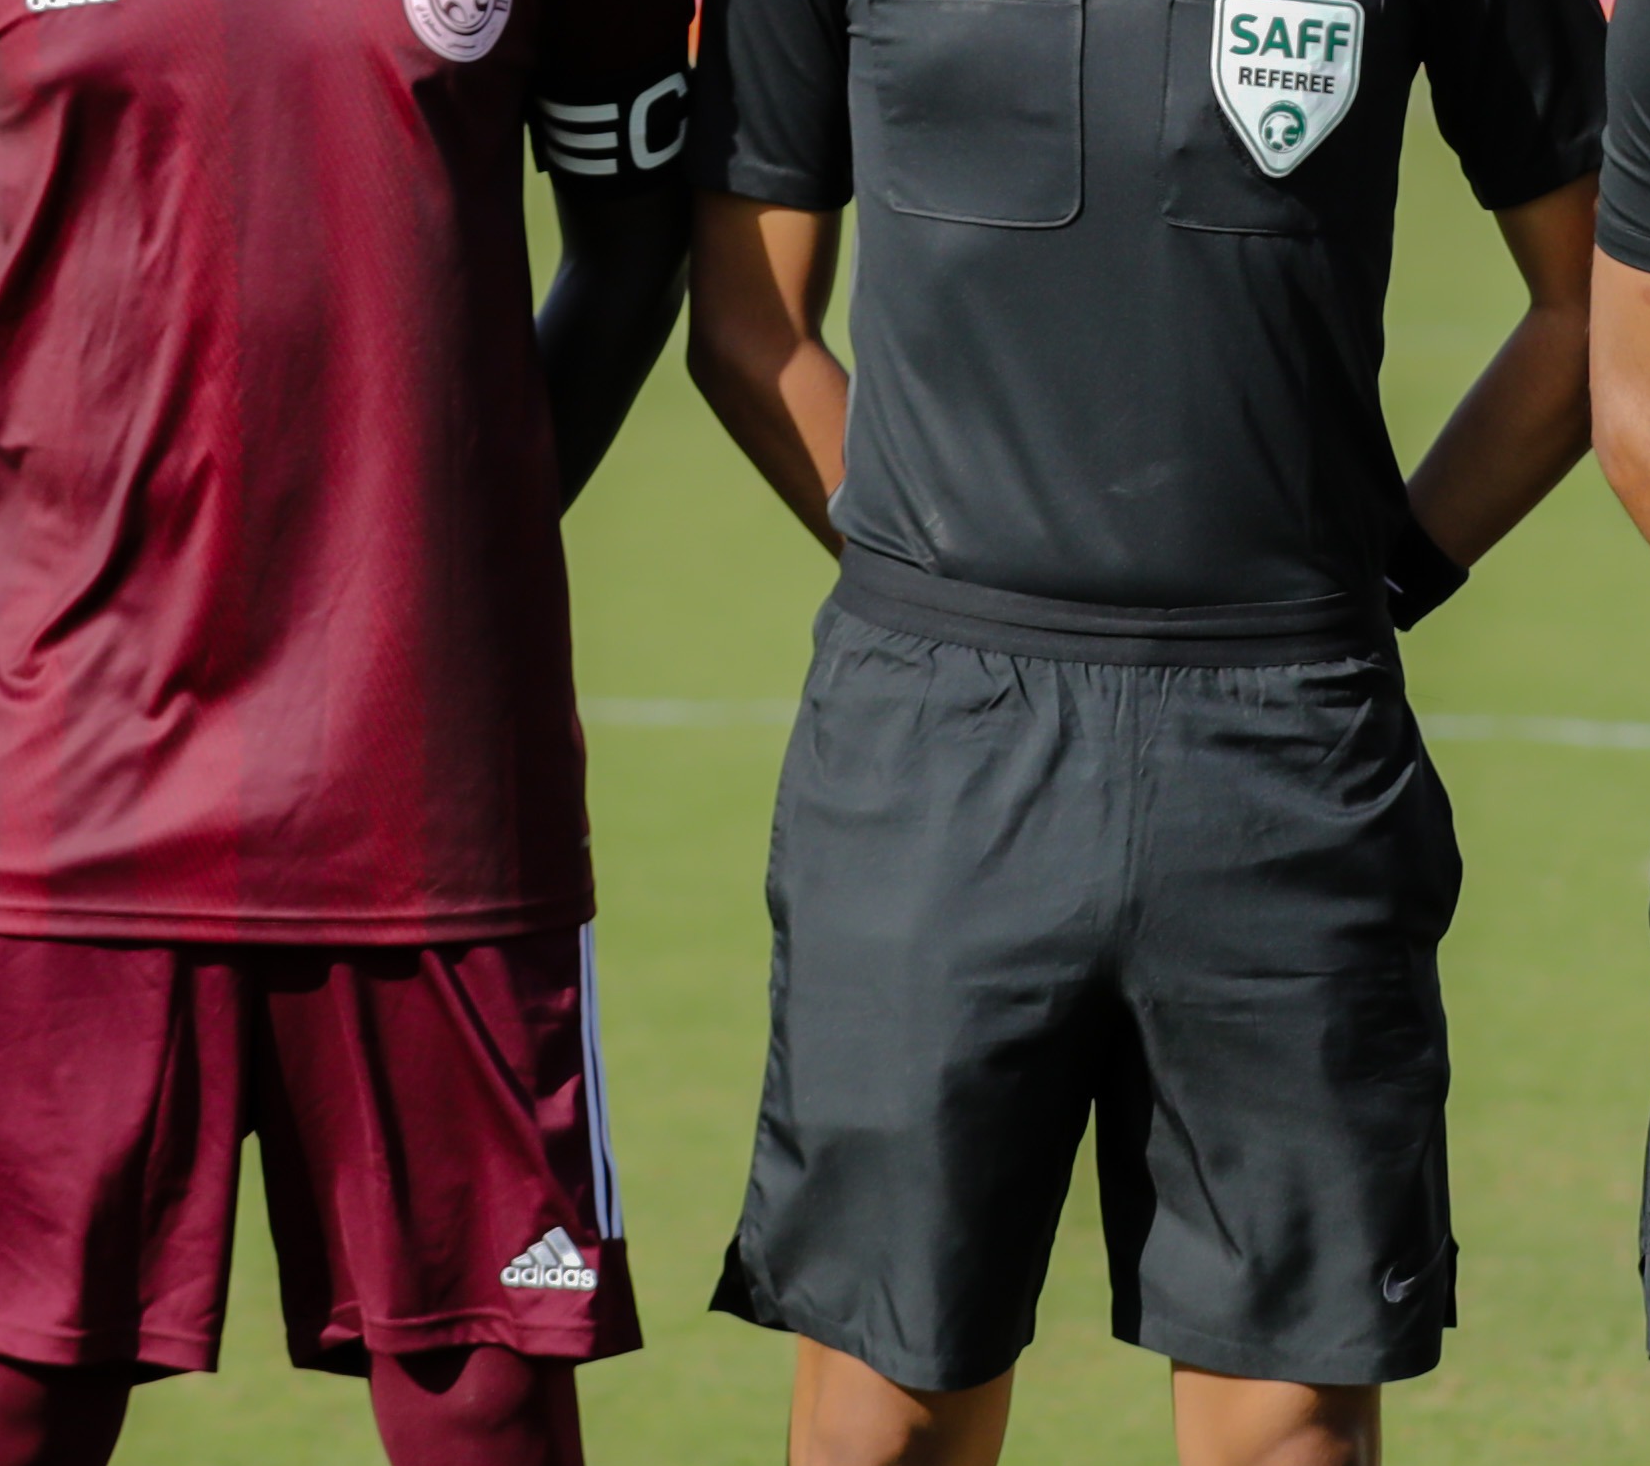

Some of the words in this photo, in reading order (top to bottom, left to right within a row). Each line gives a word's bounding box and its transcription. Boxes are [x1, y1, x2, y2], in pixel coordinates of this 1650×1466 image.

[1228, 13, 1351, 63] SAFF
[1237, 66, 1336, 95] REFEREE
[499, 1263, 598, 1292] adidas
